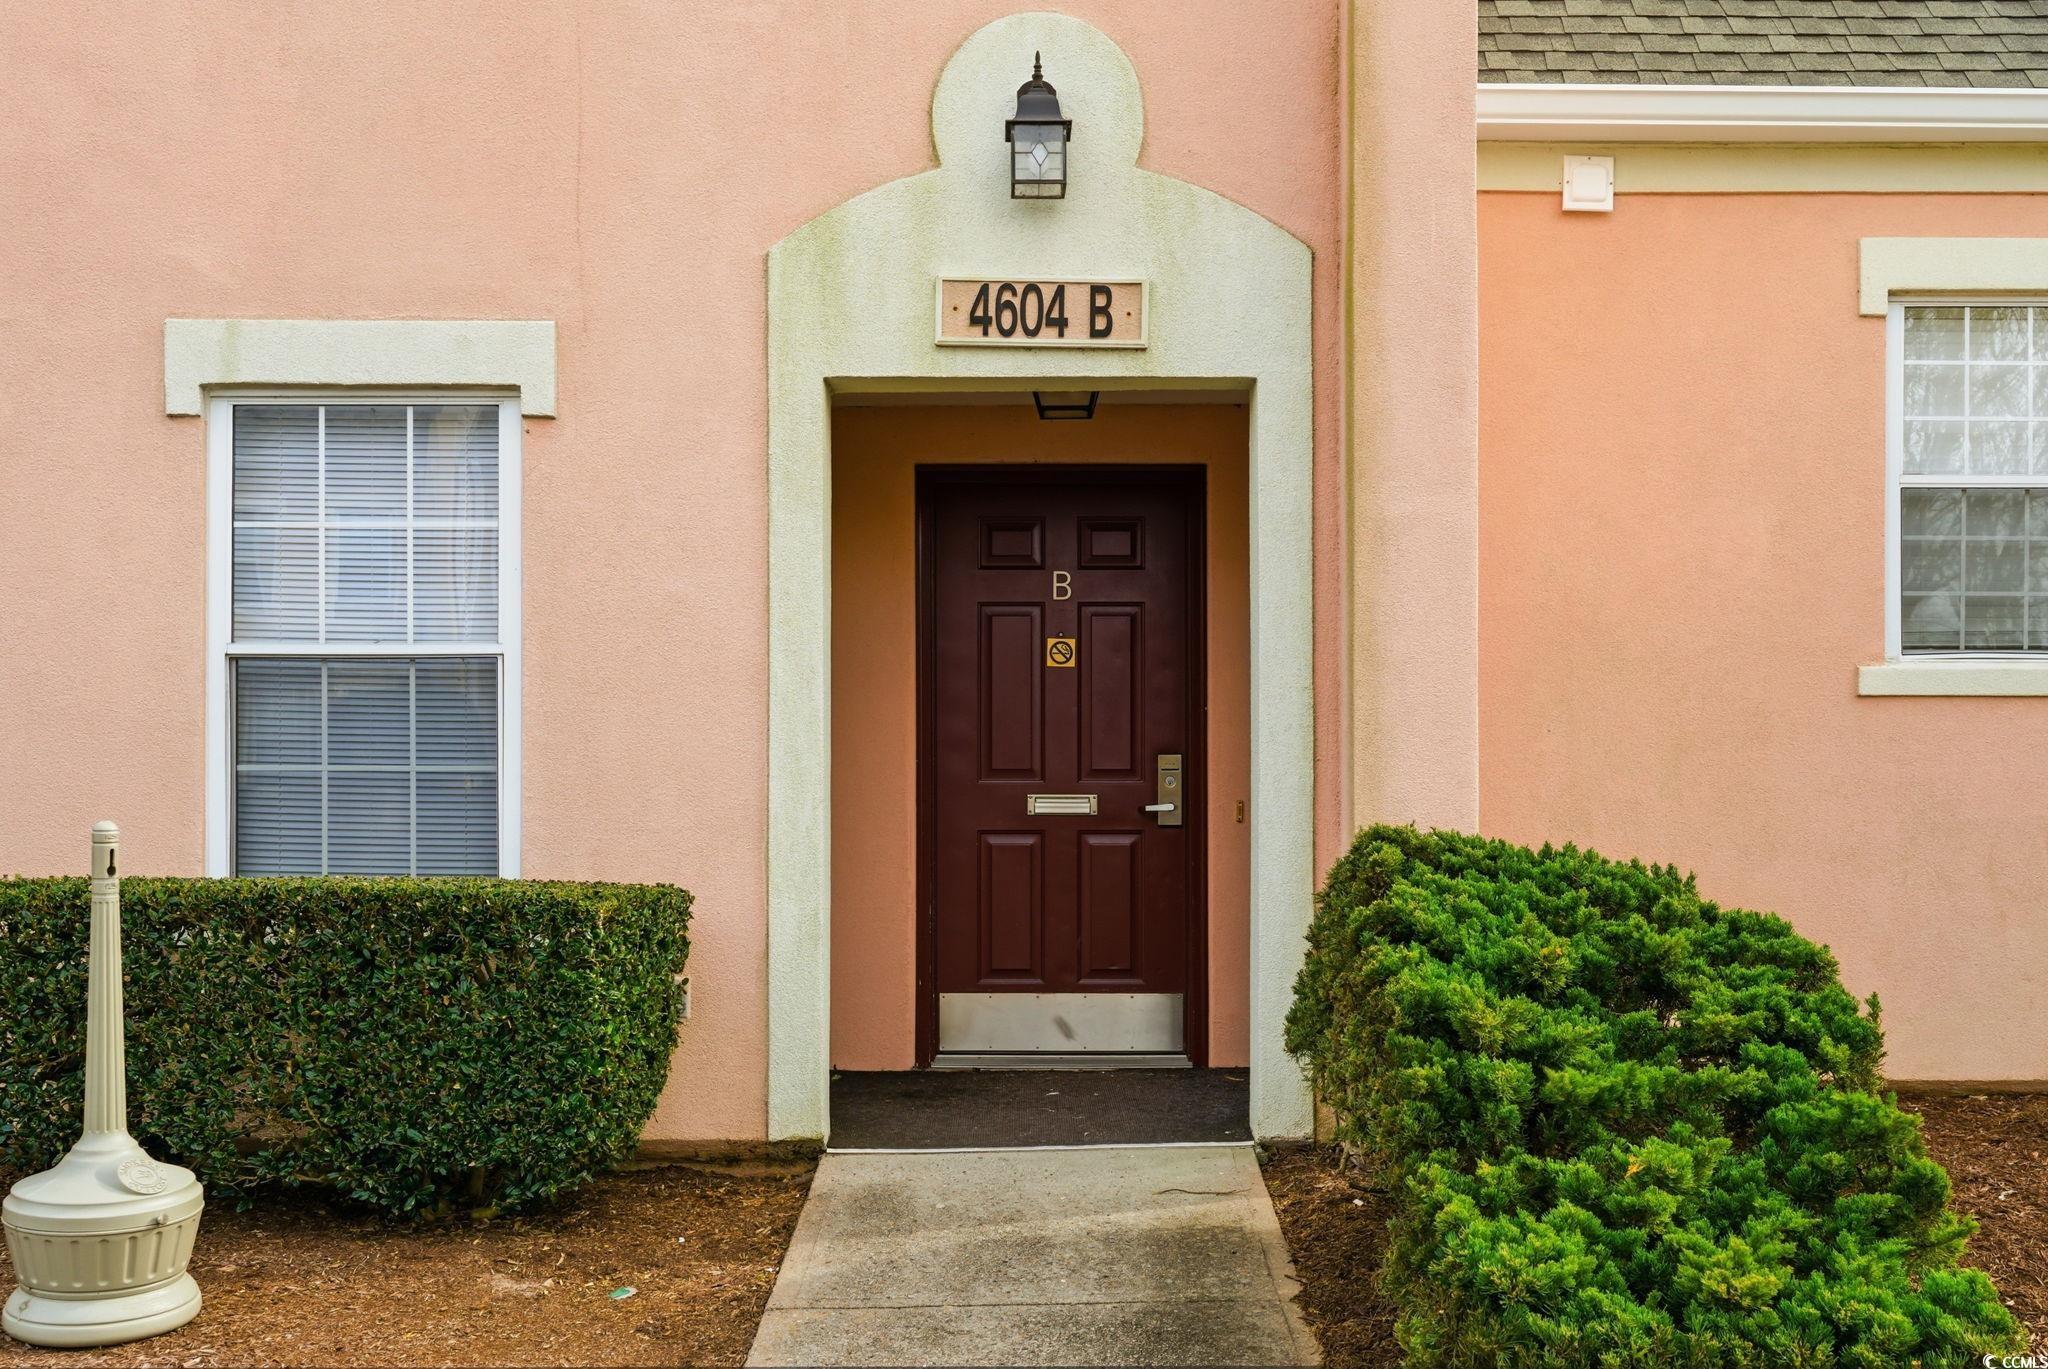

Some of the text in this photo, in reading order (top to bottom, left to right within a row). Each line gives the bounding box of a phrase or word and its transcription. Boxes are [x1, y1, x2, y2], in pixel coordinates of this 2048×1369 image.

[969, 282, 1114, 338] 4604 B
[1052, 570, 1072, 601] B
